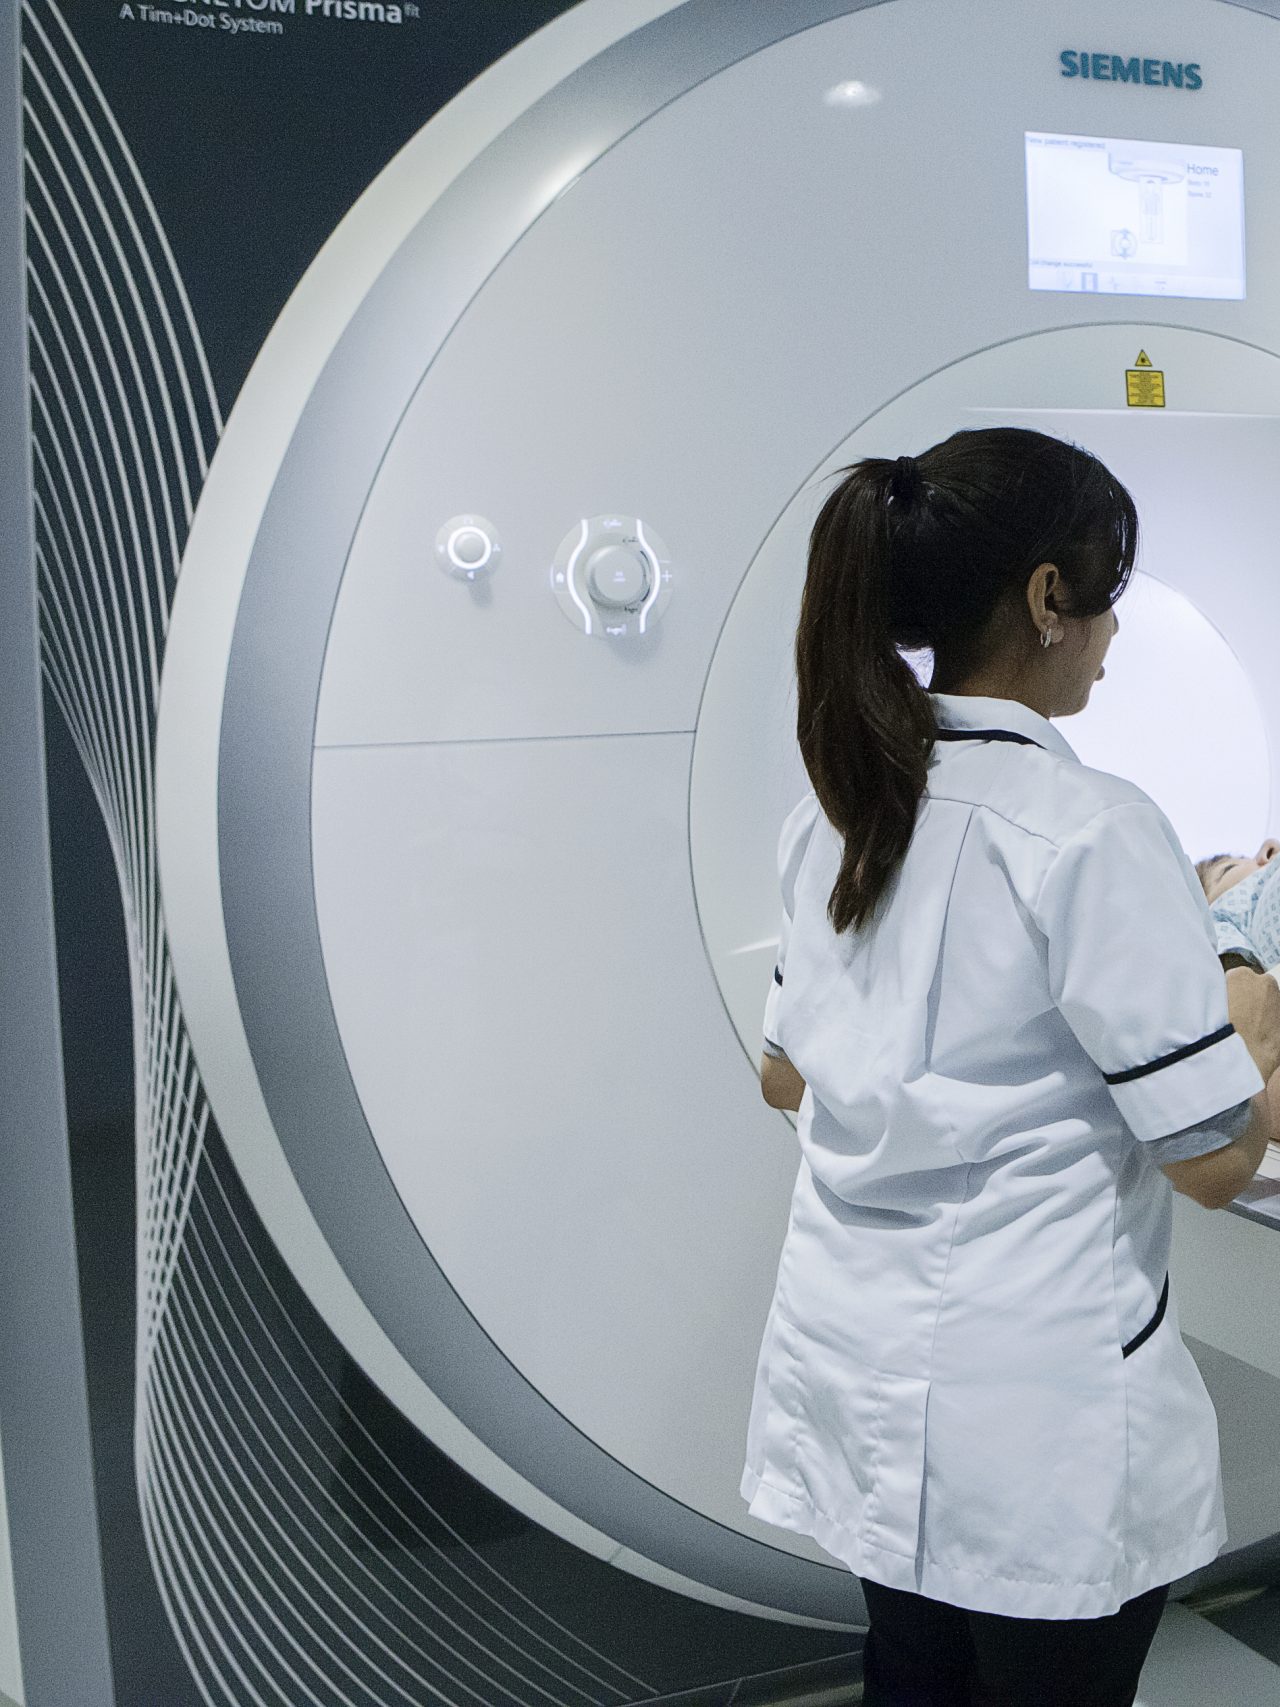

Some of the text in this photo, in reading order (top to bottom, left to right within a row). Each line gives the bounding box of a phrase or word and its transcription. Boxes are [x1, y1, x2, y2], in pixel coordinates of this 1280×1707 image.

[119, 3, 135, 20] A
[137, 4, 216, 28] Tim+Dot
[219, 12, 283, 35] System
[304, 0, 402, 24] Prisma
[1060, 50, 1203, 90] SIEMENS
[1187, 163, 1219, 177] Home
